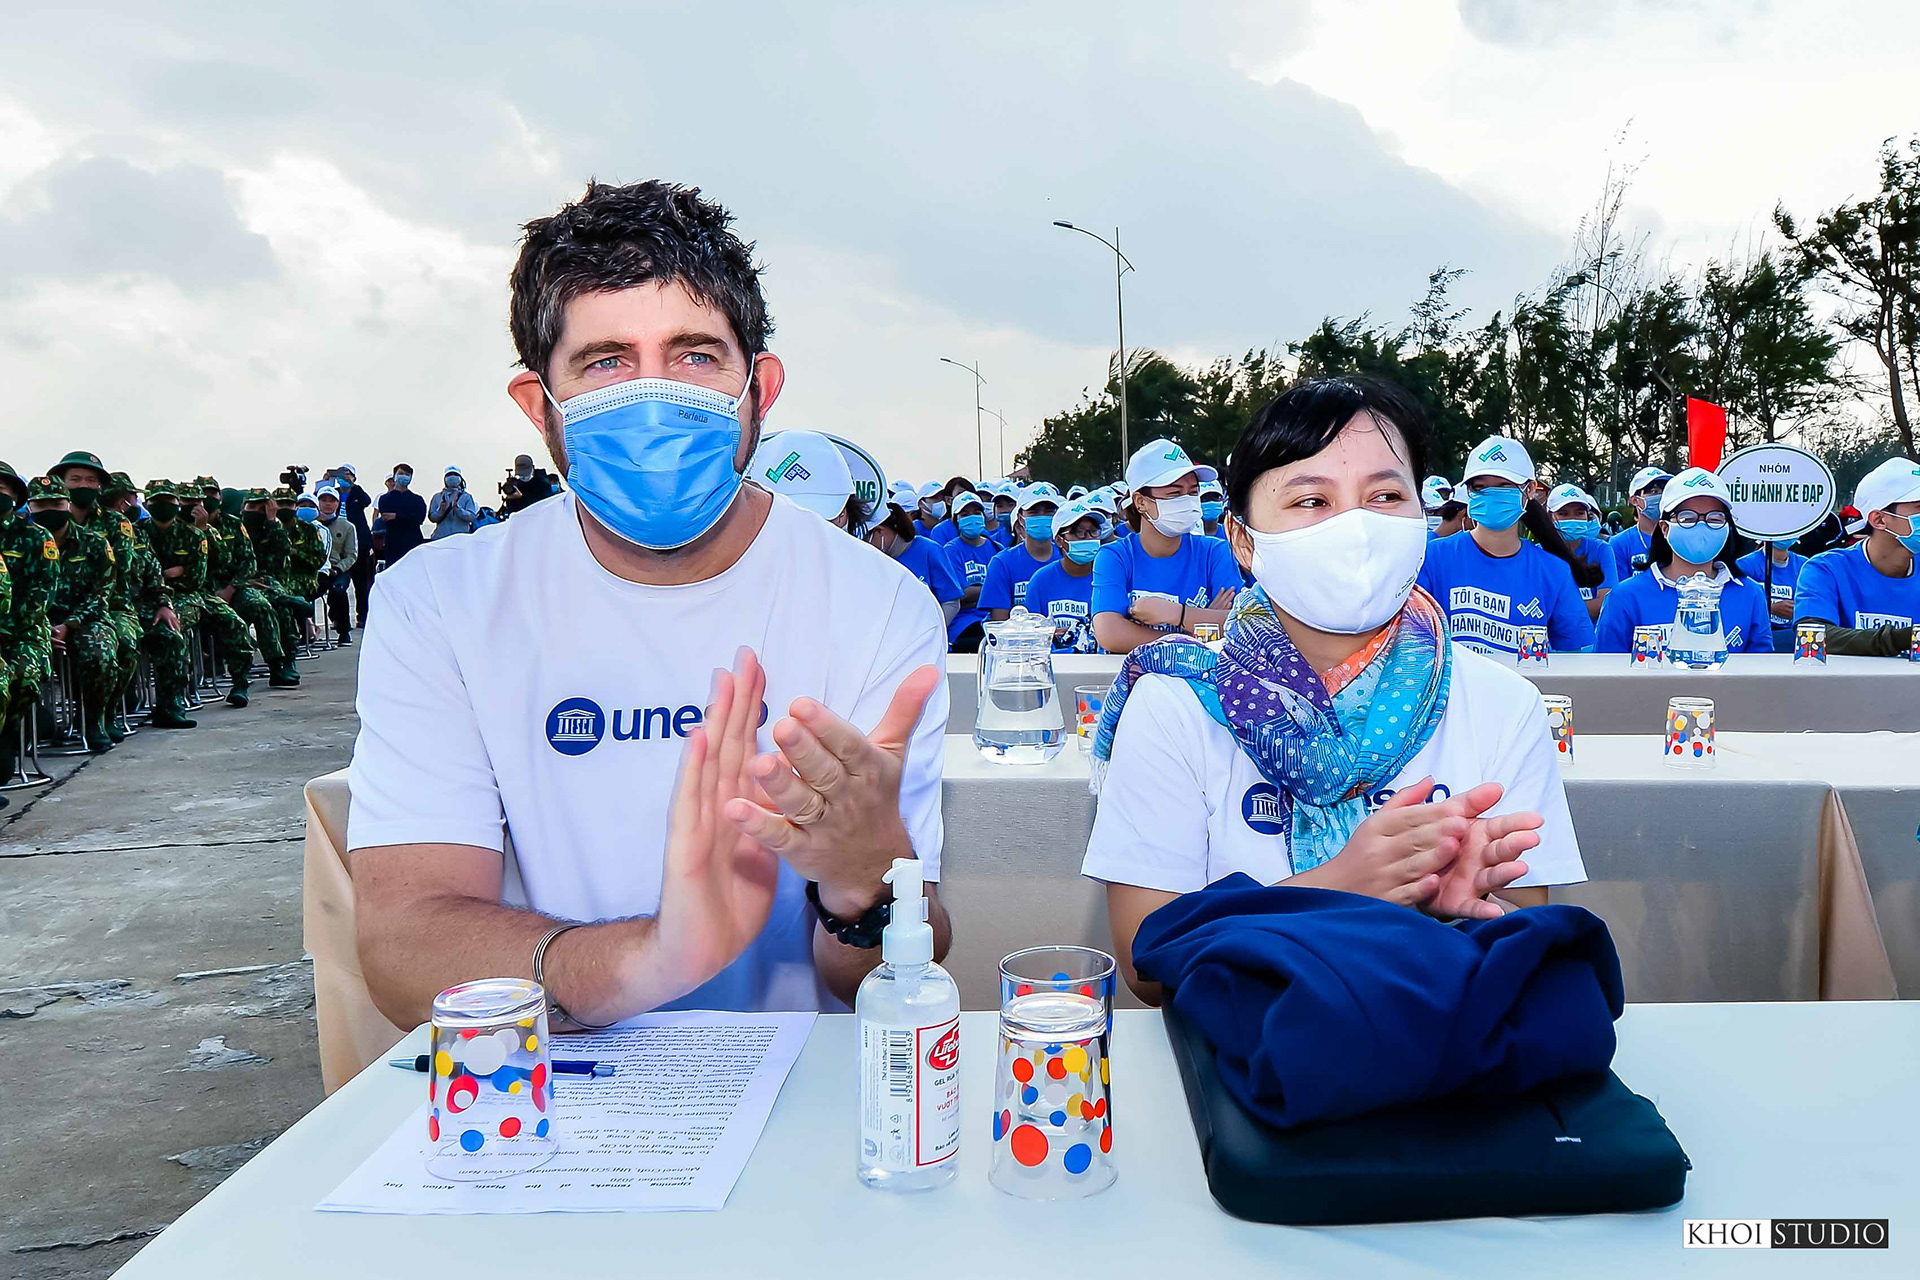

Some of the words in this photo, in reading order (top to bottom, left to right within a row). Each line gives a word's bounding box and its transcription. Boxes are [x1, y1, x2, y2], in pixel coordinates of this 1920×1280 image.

[1759, 462, 1791, 473] NHÓM
[1751, 480, 1782, 502] HÀNH
[1785, 484, 1799, 502] XE
[1802, 484, 1824, 507] ĐẠP
[1453, 589, 1471, 605] TÔI
[1473, 592, 1480, 604] &
[1483, 595, 1506, 613] BẠN
[1452, 615, 1481, 634] HÀNH
[1483, 622, 1513, 643] ĐỘNG
[934, 1077, 946, 1087] GEL
